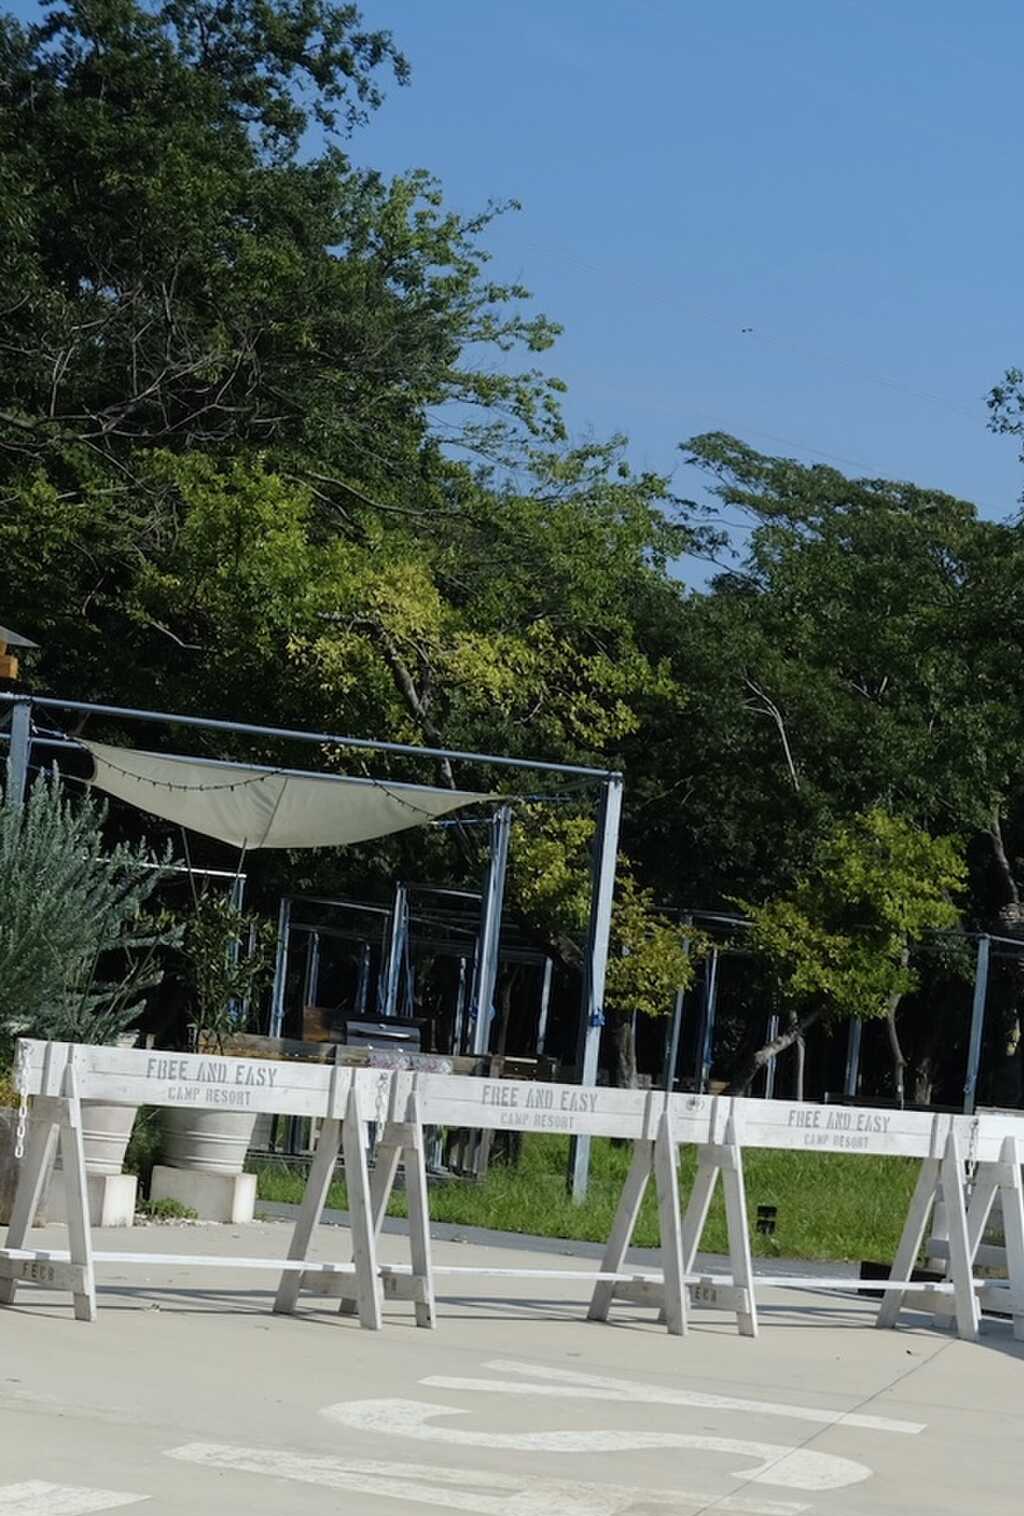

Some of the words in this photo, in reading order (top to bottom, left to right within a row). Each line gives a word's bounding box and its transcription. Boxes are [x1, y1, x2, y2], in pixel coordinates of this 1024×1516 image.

[146, 1057, 189, 1081] FREE
[196, 1061, 228, 1085] AND
[235, 1064, 278, 1088] EASY
[167, 1086, 201, 1101] CAMP
[205, 1088, 251, 1106] RESORT
[481, 1084, 520, 1107] FREE
[525, 1087, 554, 1109] AND
[560, 1090, 599, 1113] EASY
[499, 1111, 530, 1125] CAMP
[533, 1113, 577, 1129] RESORT
[787, 1109, 822, 1128] FREE
[826, 1110, 852, 1130] AND
[856, 1113, 891, 1134] EASY
[803, 1133, 829, 1145] CAMP
